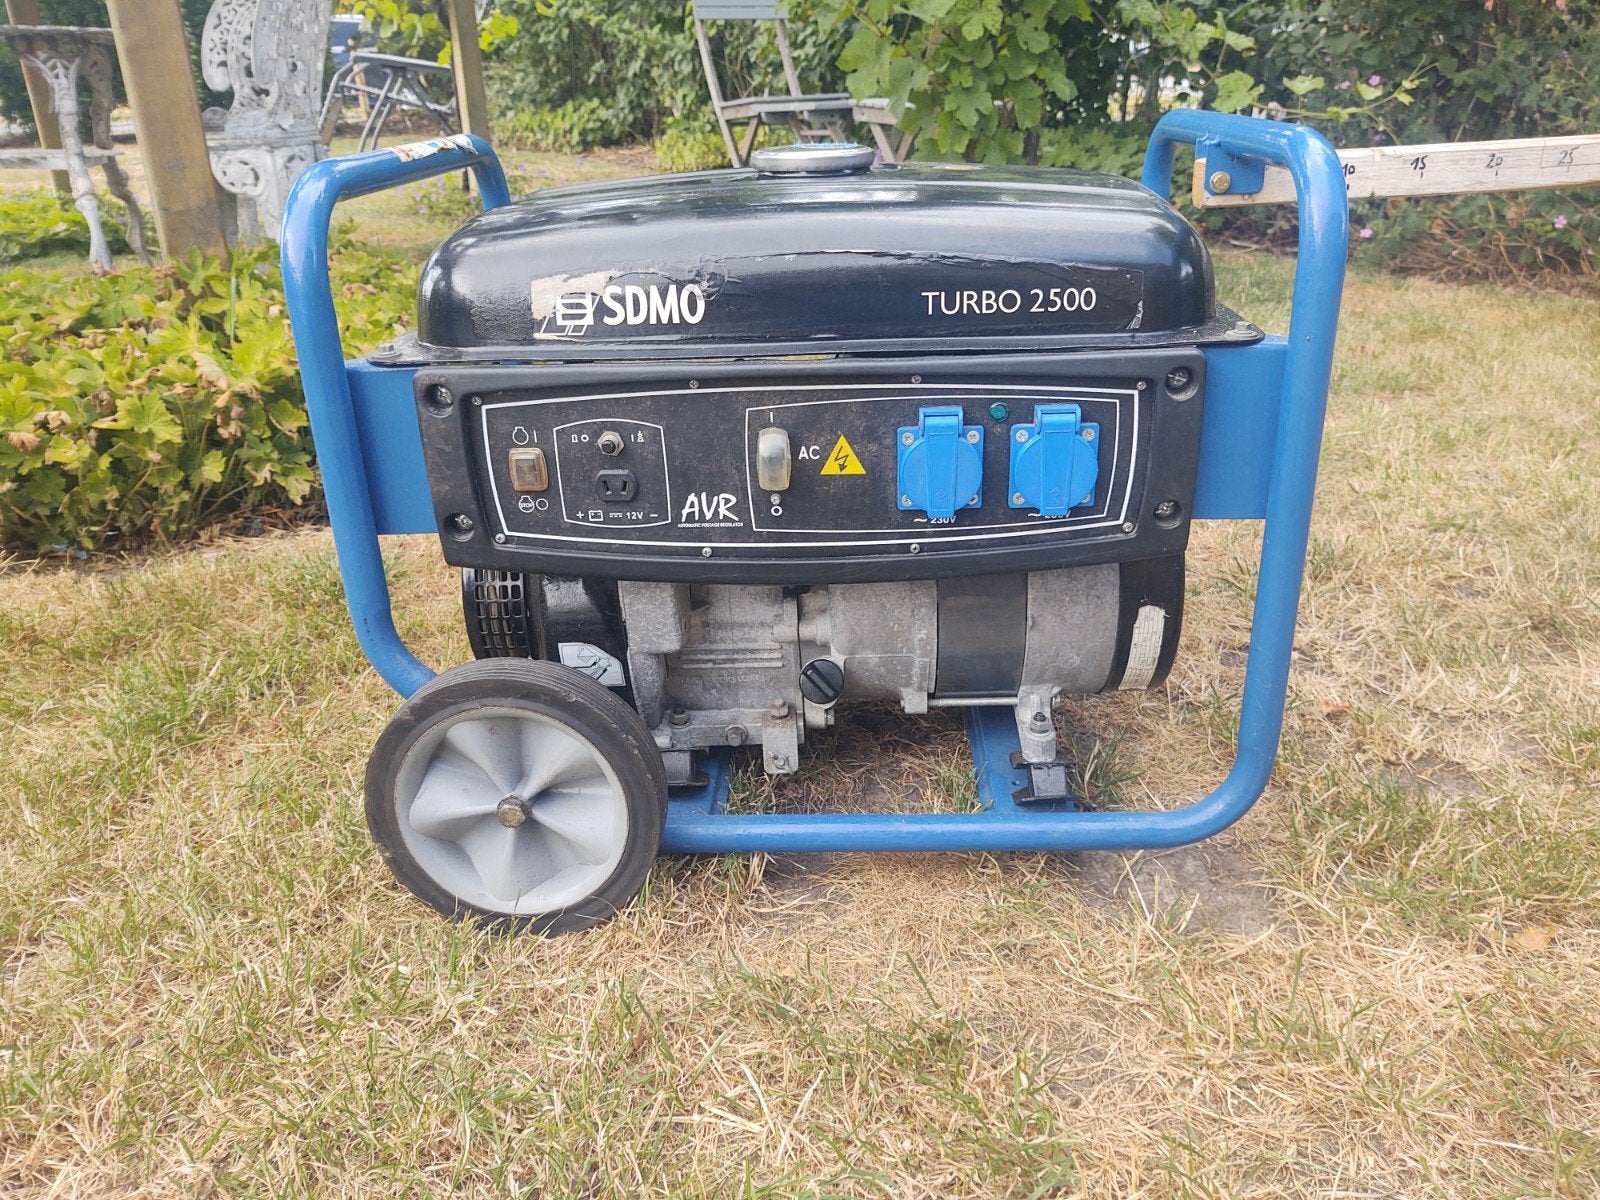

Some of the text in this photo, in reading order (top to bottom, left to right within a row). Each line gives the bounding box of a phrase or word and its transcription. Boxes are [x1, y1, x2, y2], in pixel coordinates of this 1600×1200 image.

[1342, 146, 1580, 177] 10 15 20 25
[602, 284, 706, 326] SDMO
[921, 287, 1097, 315] TURBO 2500
[798, 445, 821, 460] AC
[625, 511, 644, 520] 12V
[681, 491, 739, 522] AVR
